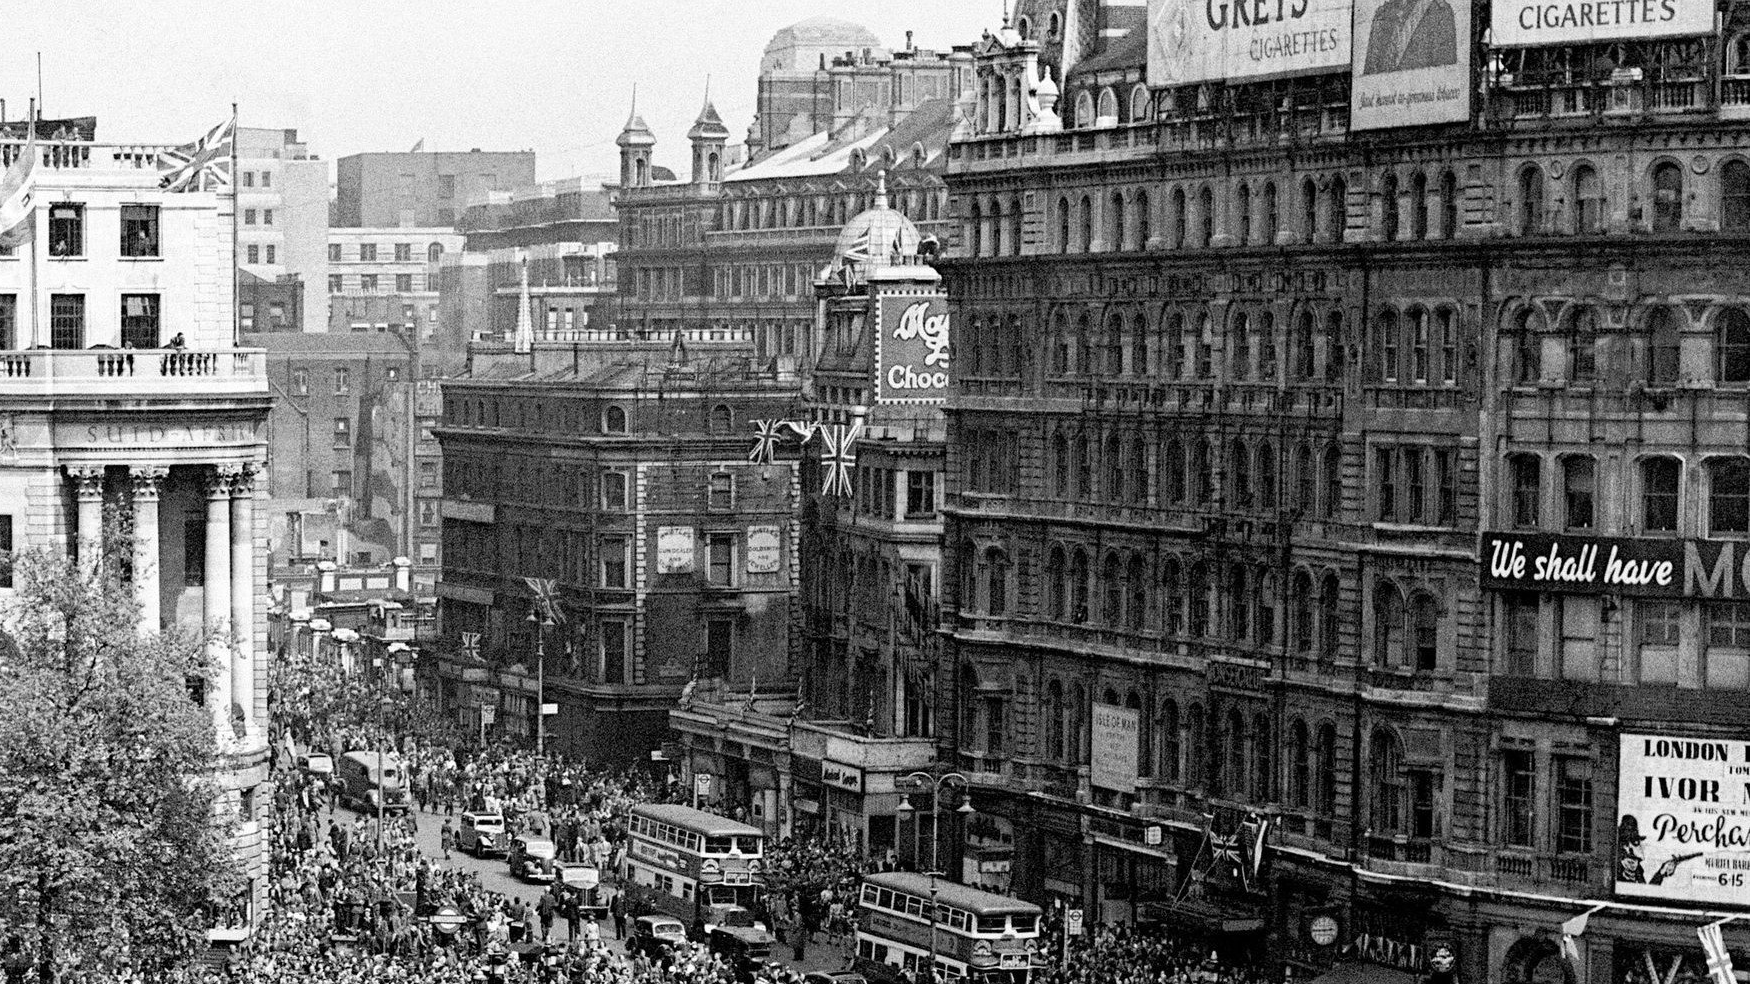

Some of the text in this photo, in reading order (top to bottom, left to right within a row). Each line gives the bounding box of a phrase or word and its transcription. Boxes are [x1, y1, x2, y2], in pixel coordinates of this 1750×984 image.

[1519, 0, 1675, 30] CIGARETTES
[1250, 28, 1337, 61] CIGARETTES
[1491, 540, 1525, 579] We
[1533, 542, 1598, 582] shall
[1604, 545, 1673, 586] have
[1644, 739, 1728, 762] LONDON
[1644, 776, 1720, 802] IVOR
[1652, 813, 1750, 848] Percha
